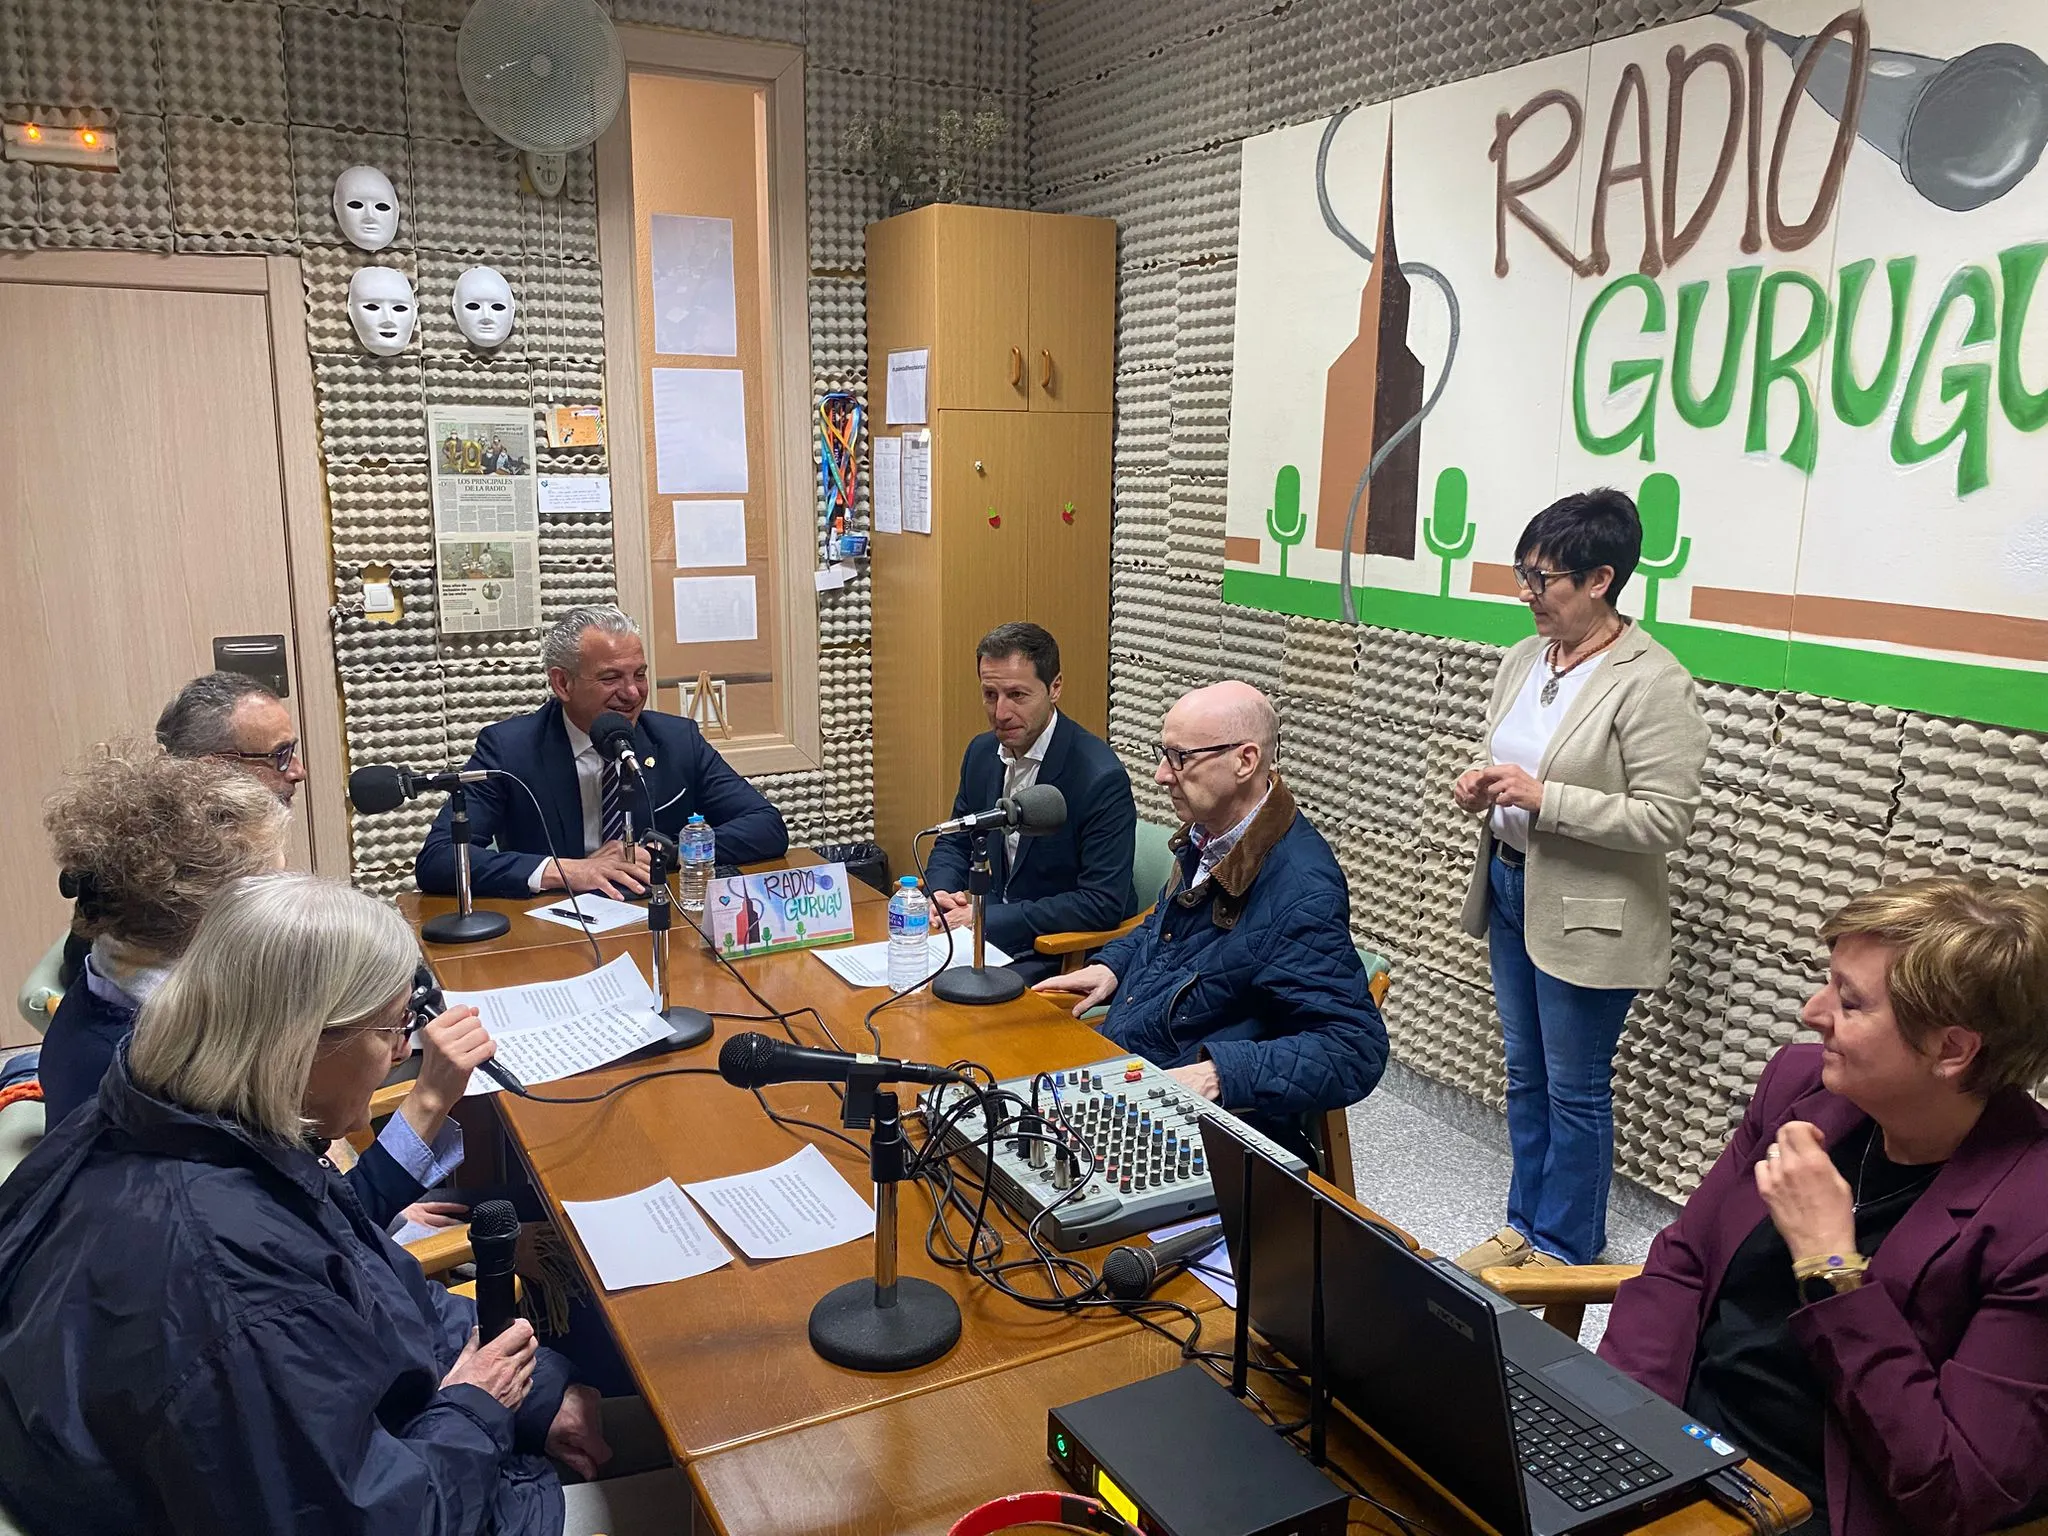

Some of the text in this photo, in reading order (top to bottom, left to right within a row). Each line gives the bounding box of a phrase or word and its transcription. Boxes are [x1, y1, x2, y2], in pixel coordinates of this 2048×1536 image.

[1488, 7, 1871, 278] RADIO
[764, 869, 815, 900] RADIO
[784, 888, 843, 921] GURUGÚ
